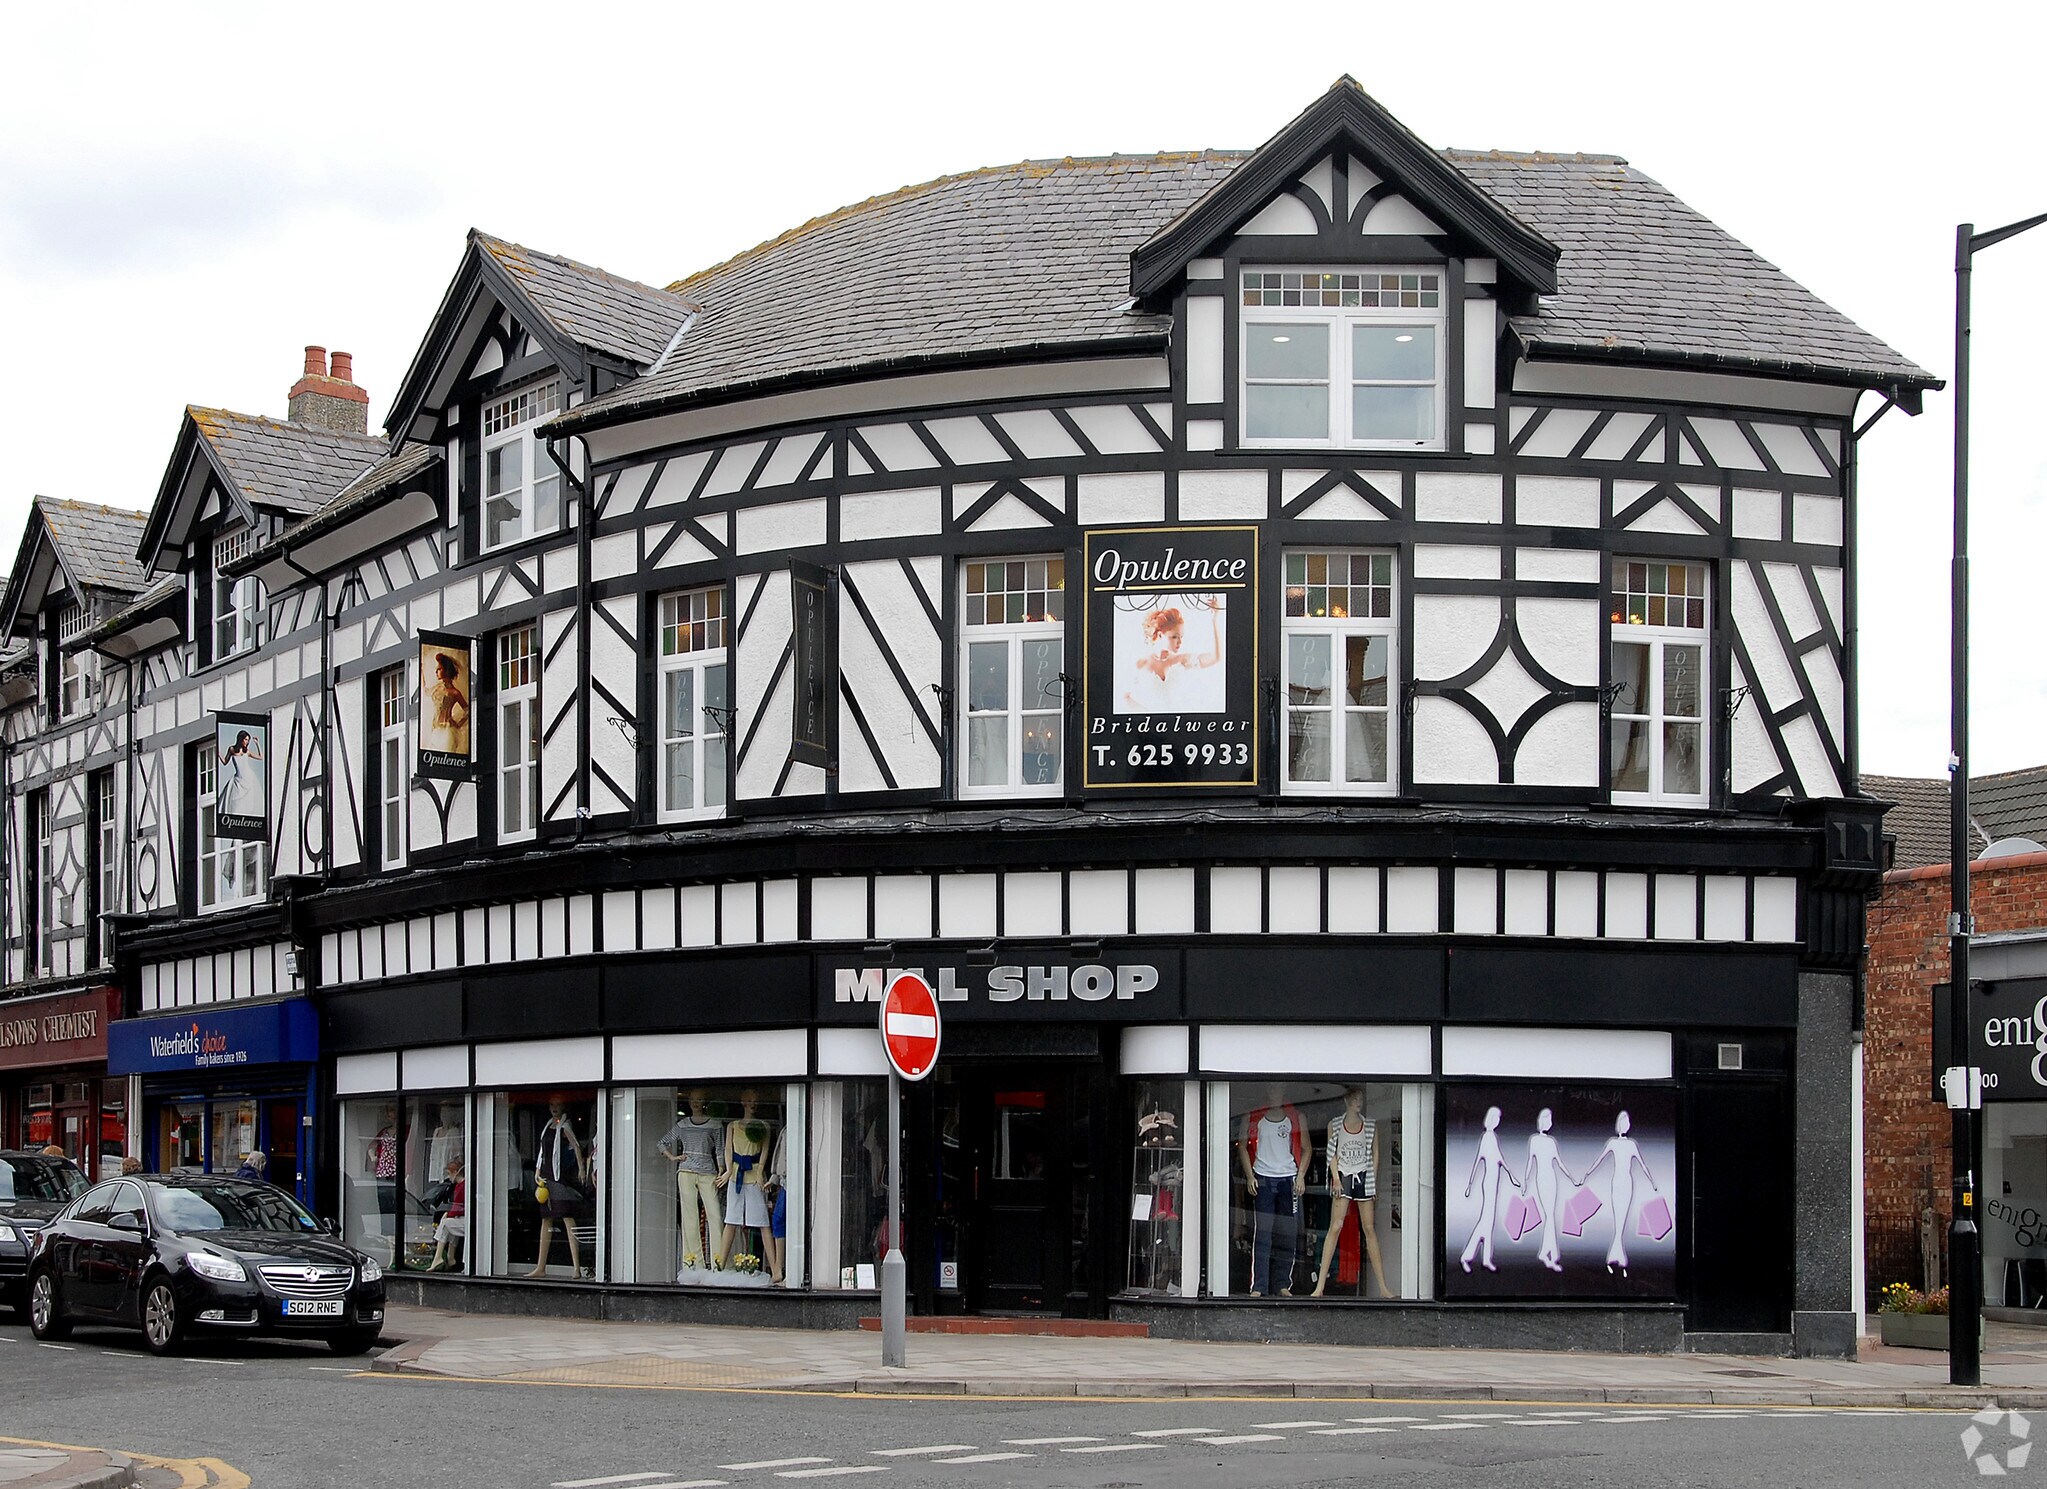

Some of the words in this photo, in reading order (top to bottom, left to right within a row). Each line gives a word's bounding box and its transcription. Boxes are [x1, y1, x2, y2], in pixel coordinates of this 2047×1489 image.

[1094, 548, 1247, 590] Opulence
[1091, 716, 1249, 734] Bridalwear
[422, 751, 467, 767] Opulence
[1092, 745, 1116, 766] T.
[1127, 744, 1174, 766] 625
[1184, 743, 1249, 766] 9933
[221, 815, 263, 829] Opulence
[835, 967, 968, 1002] ML
[987, 964, 1159, 1001] SHOP
[42, 1009, 97, 1042] CHEMIST
[150, 1026, 200, 1057] Waterfield's
[202, 1030, 227, 1053] choice
[224, 1052, 235, 1063] since
[289, 1302, 314, 1313] SG12
[316, 1302, 337, 1313] RNE
